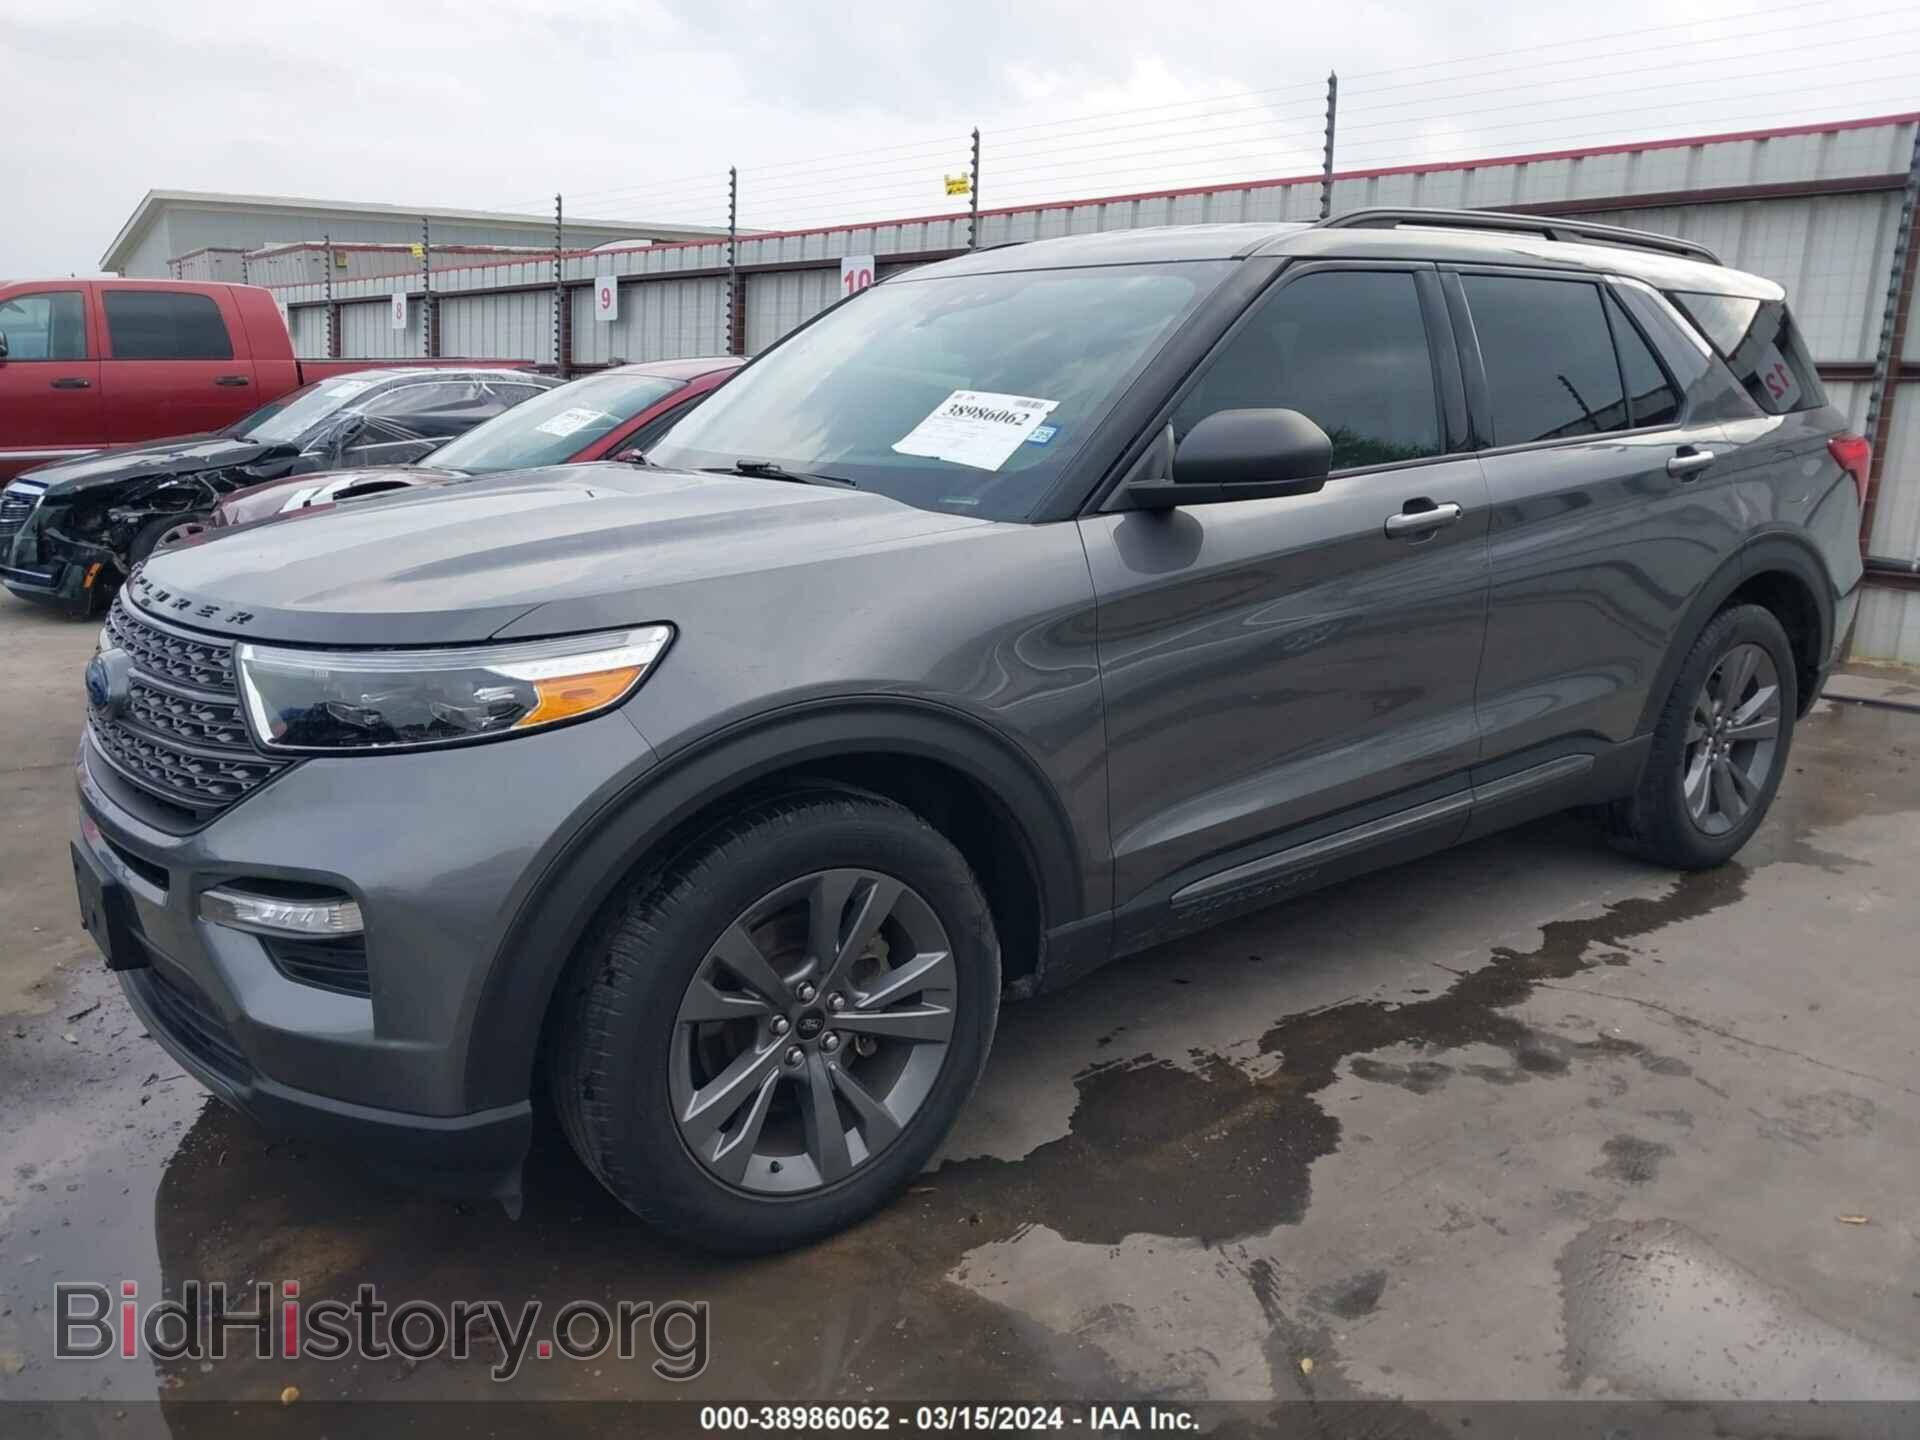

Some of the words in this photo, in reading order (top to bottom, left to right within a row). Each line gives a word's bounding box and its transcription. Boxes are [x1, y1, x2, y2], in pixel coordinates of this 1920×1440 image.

[845, 269, 872, 295] 10
[602, 287, 611, 310] 9
[396, 302, 402, 320] 8
[942, 402, 1030, 426] 38986062
